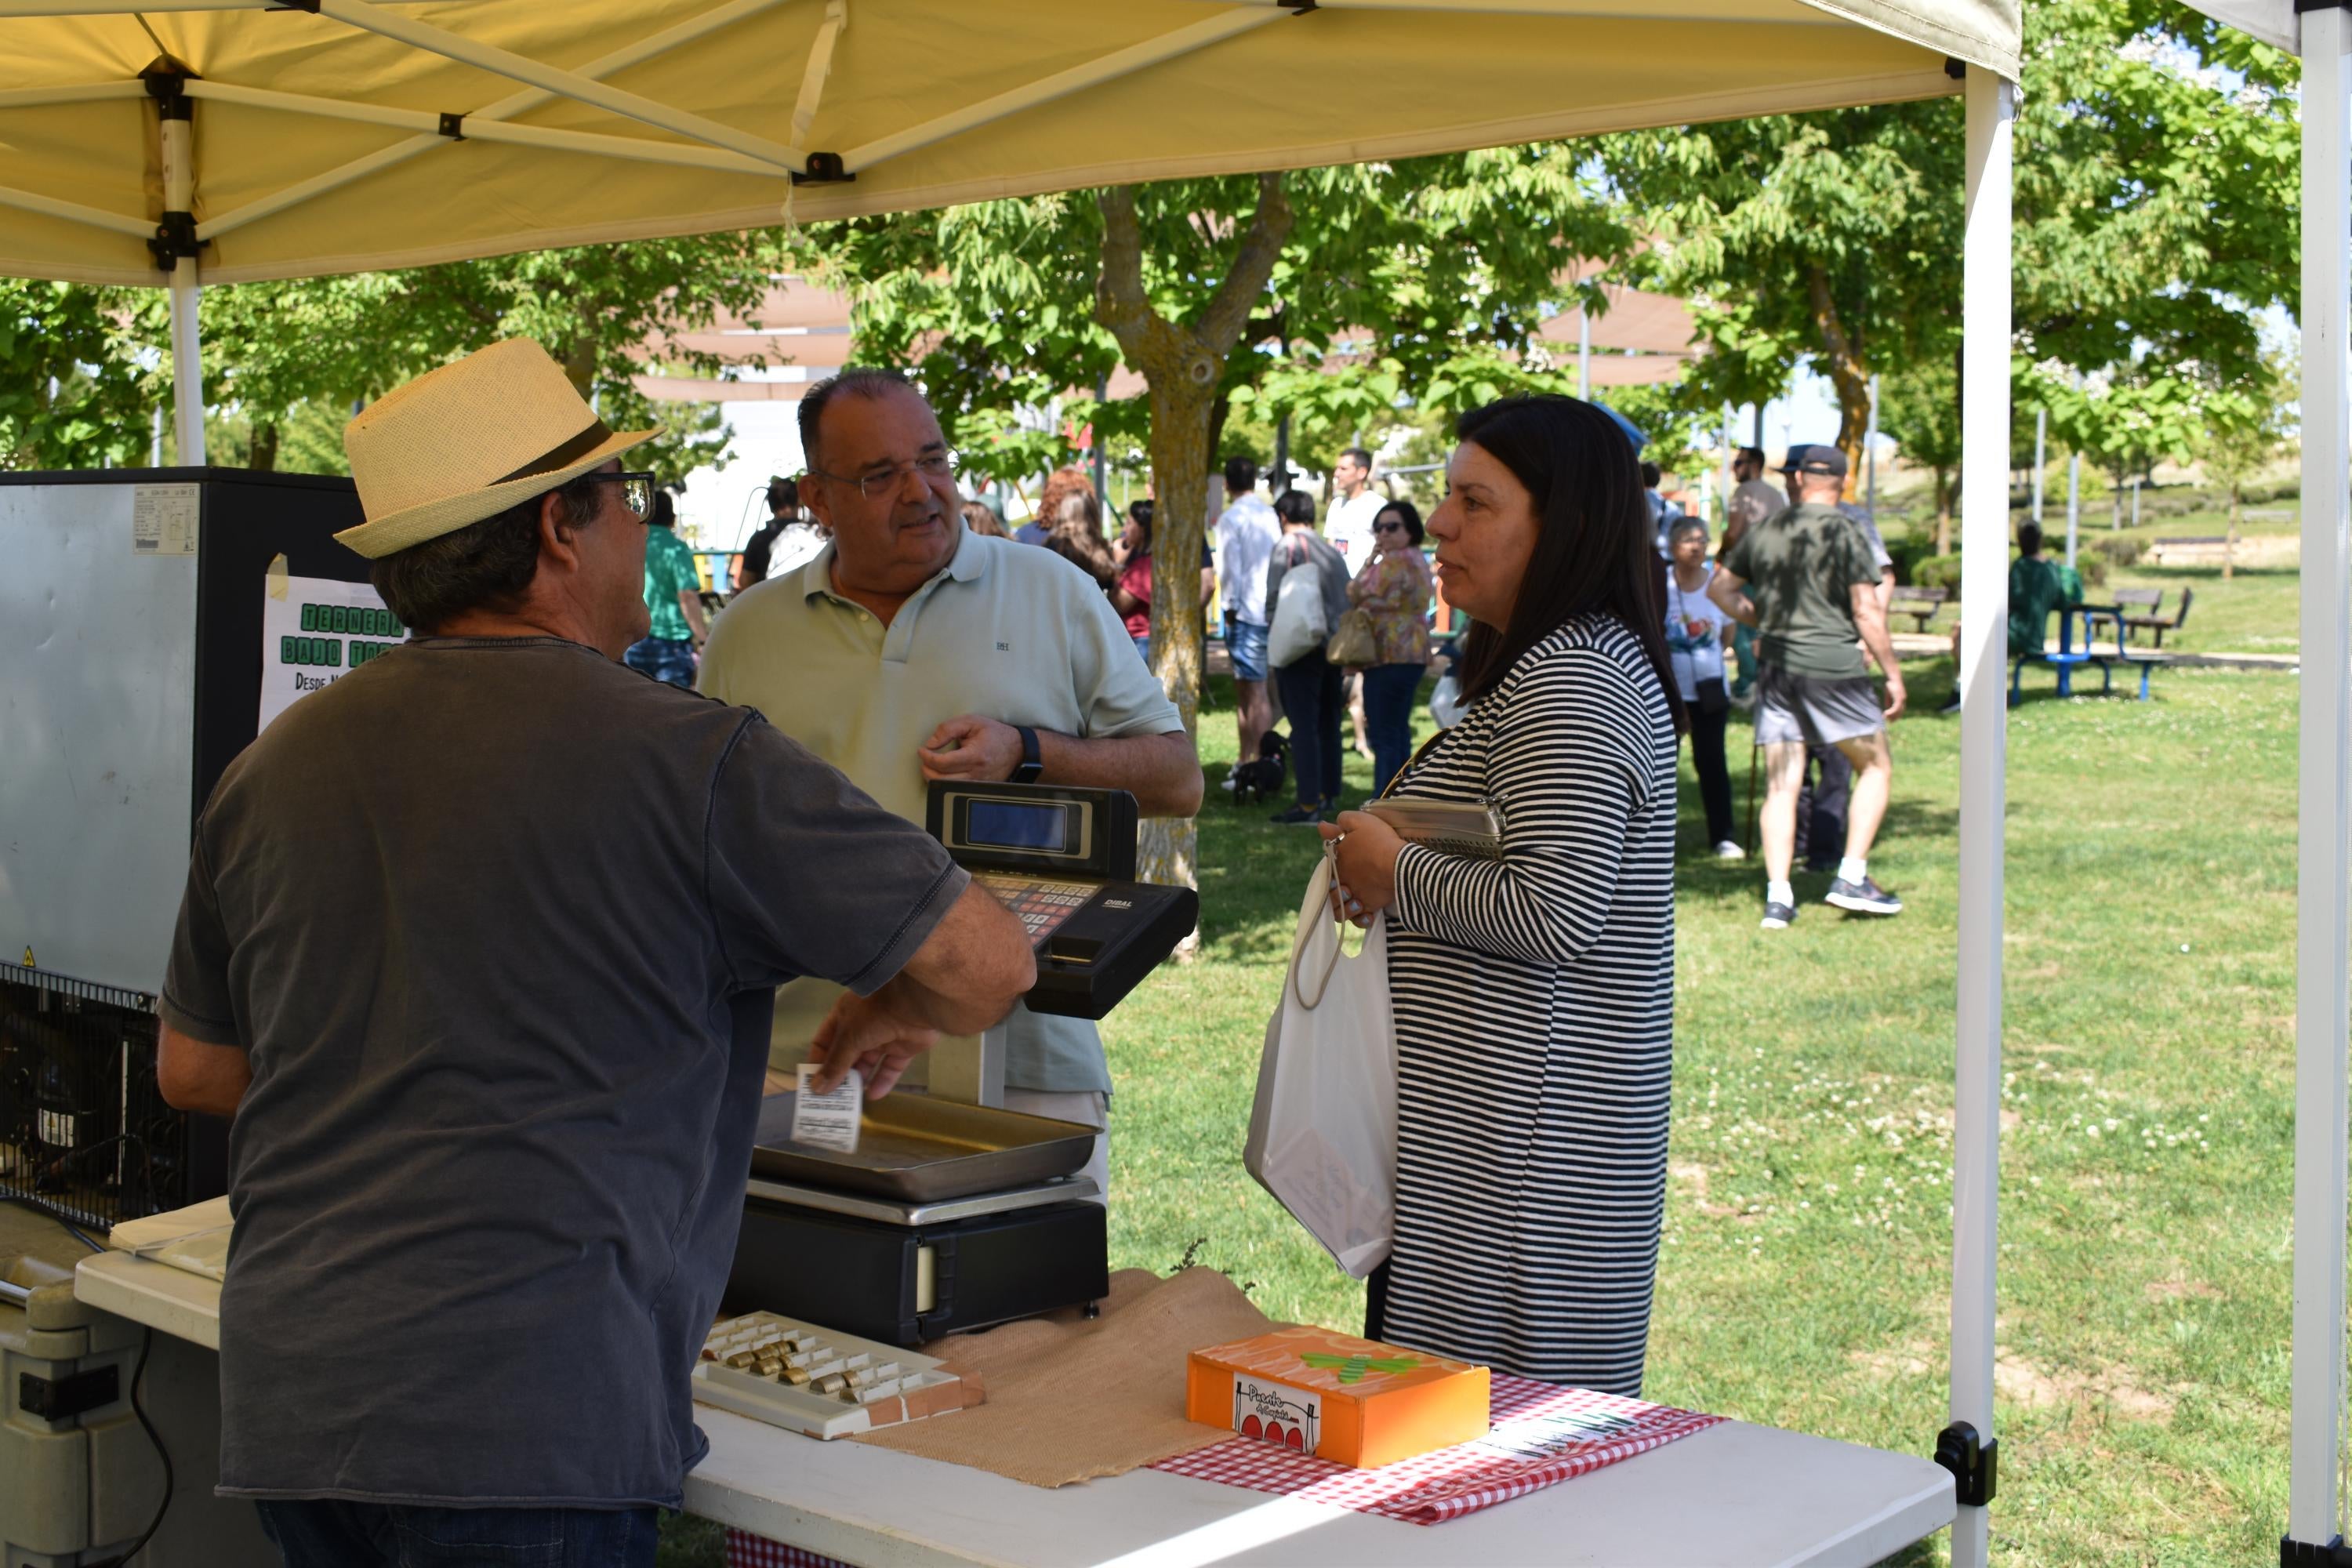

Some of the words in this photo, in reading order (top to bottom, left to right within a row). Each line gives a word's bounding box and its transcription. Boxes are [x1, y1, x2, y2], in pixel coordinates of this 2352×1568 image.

[303, 605, 404, 636] TERNERA
[283, 638, 339, 665] BAJO
[1248, 1383, 1284, 1407] Puente
